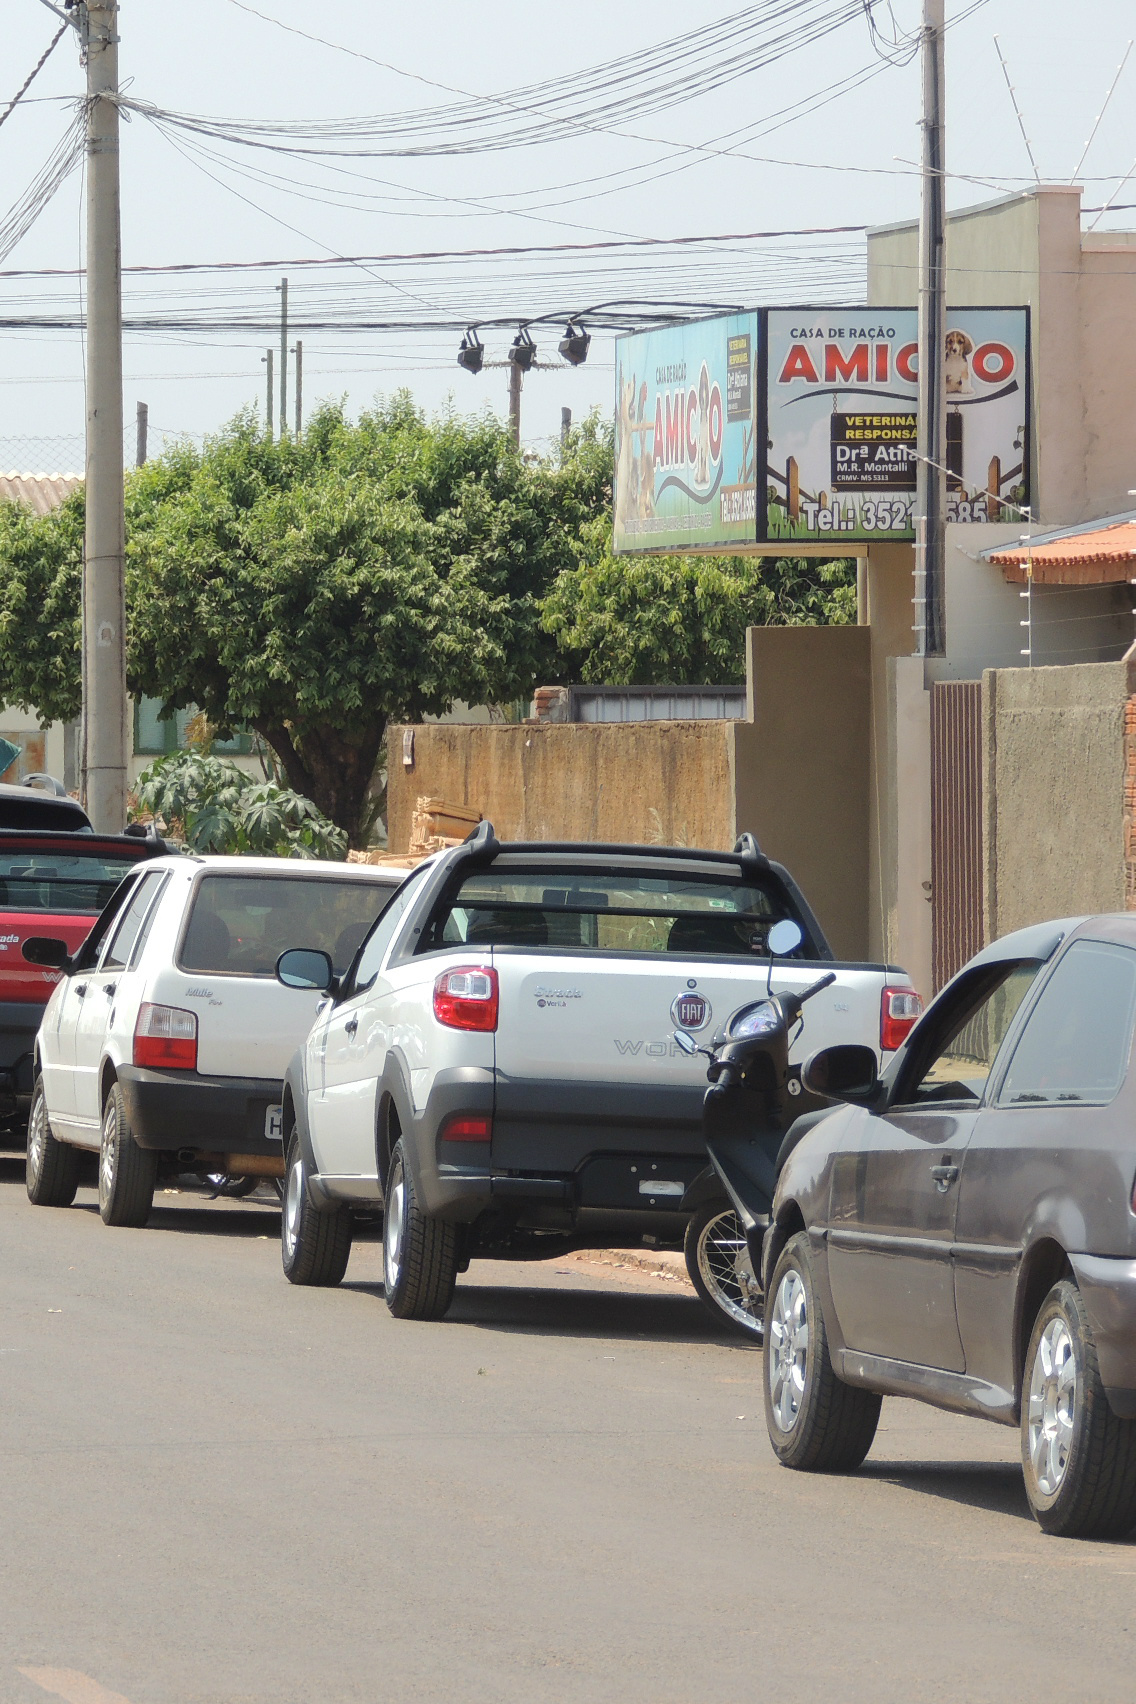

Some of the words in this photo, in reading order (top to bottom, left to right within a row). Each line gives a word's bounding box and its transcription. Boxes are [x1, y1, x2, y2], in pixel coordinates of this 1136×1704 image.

[789, 327, 825, 339] CASA
[828, 327, 845, 338] DE
[849, 325, 896, 341] RAÇÃO
[845, 414, 917, 426] VETERINÁ
[845, 428, 917, 439] RESPONSÁ
[836, 462, 861, 472] M.R.
[864, 462, 908, 472] Montalli
[802, 501, 855, 531] Tel.:
[41, 971, 63, 984] W
[533, 984, 584, 999] Strada
[681, 1003, 703, 1021] FIAT
[269, 1116, 282, 1136] H
